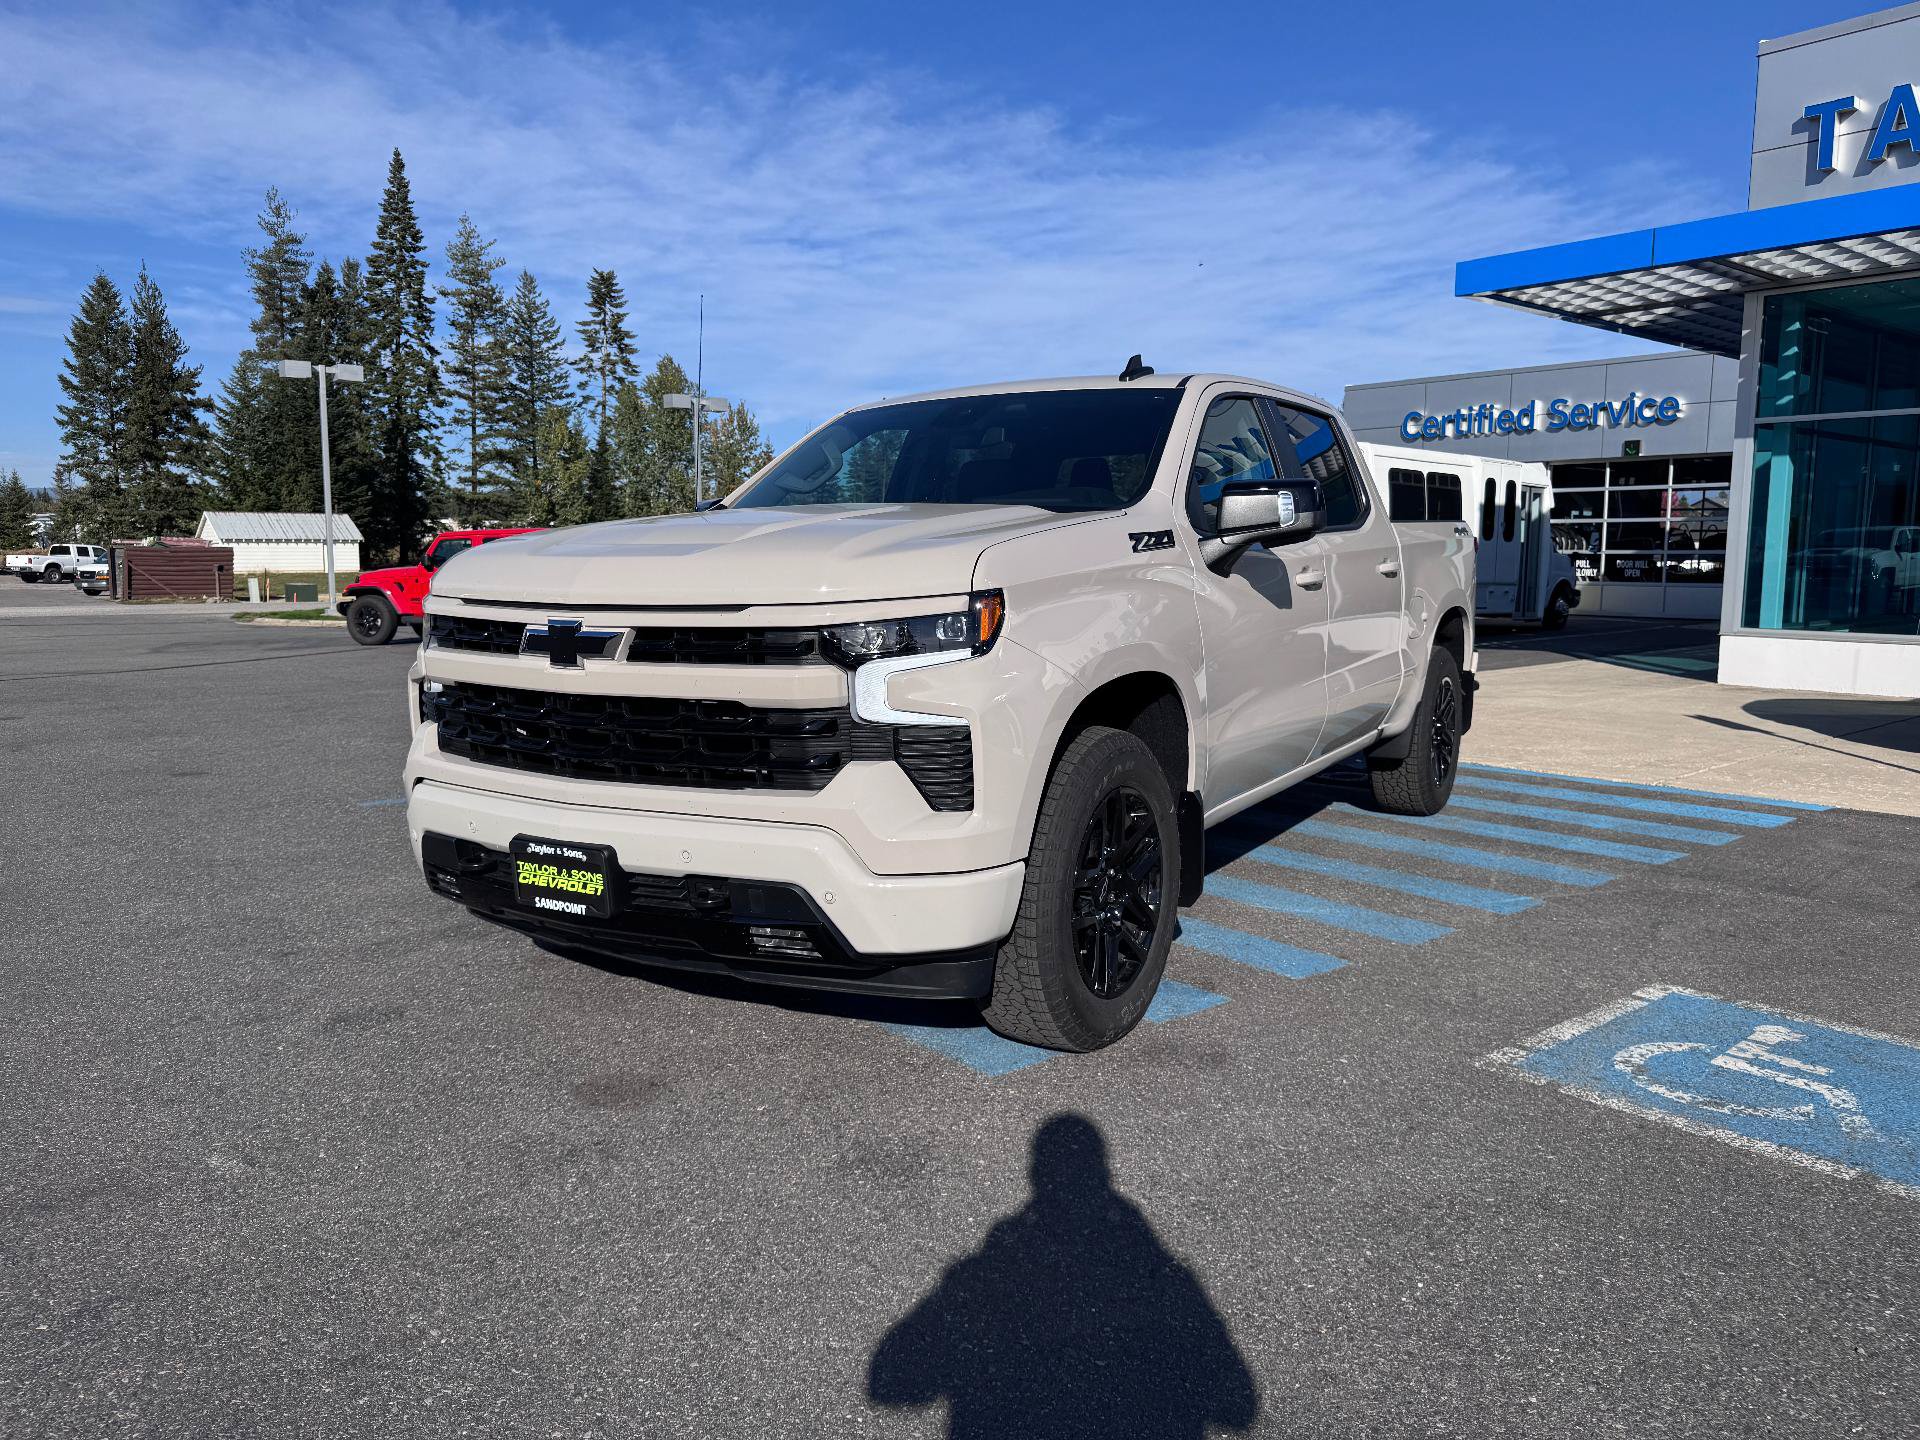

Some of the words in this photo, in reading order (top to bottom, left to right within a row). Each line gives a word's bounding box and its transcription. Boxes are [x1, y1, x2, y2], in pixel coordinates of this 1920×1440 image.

[1401, 400, 1536, 439] Certified
[1549, 392, 1680, 429] Service
[1128, 529, 1175, 553] Z71
[1575, 560, 1591, 568] PULL
[1616, 560, 1634, 568] DOOR
[1634, 560, 1649, 568] WILL
[1624, 569, 1641, 577] OPEN
[528, 843, 555, 855] Taylor
[563, 848, 582, 859] Sons
[517, 861, 557, 875] TAYLOR
[561, 869, 569, 879] &
[571, 869, 603, 884] SONS
[518, 872, 604, 896] CHEVROLET
[535, 897, 587, 916] SANDPOINT
